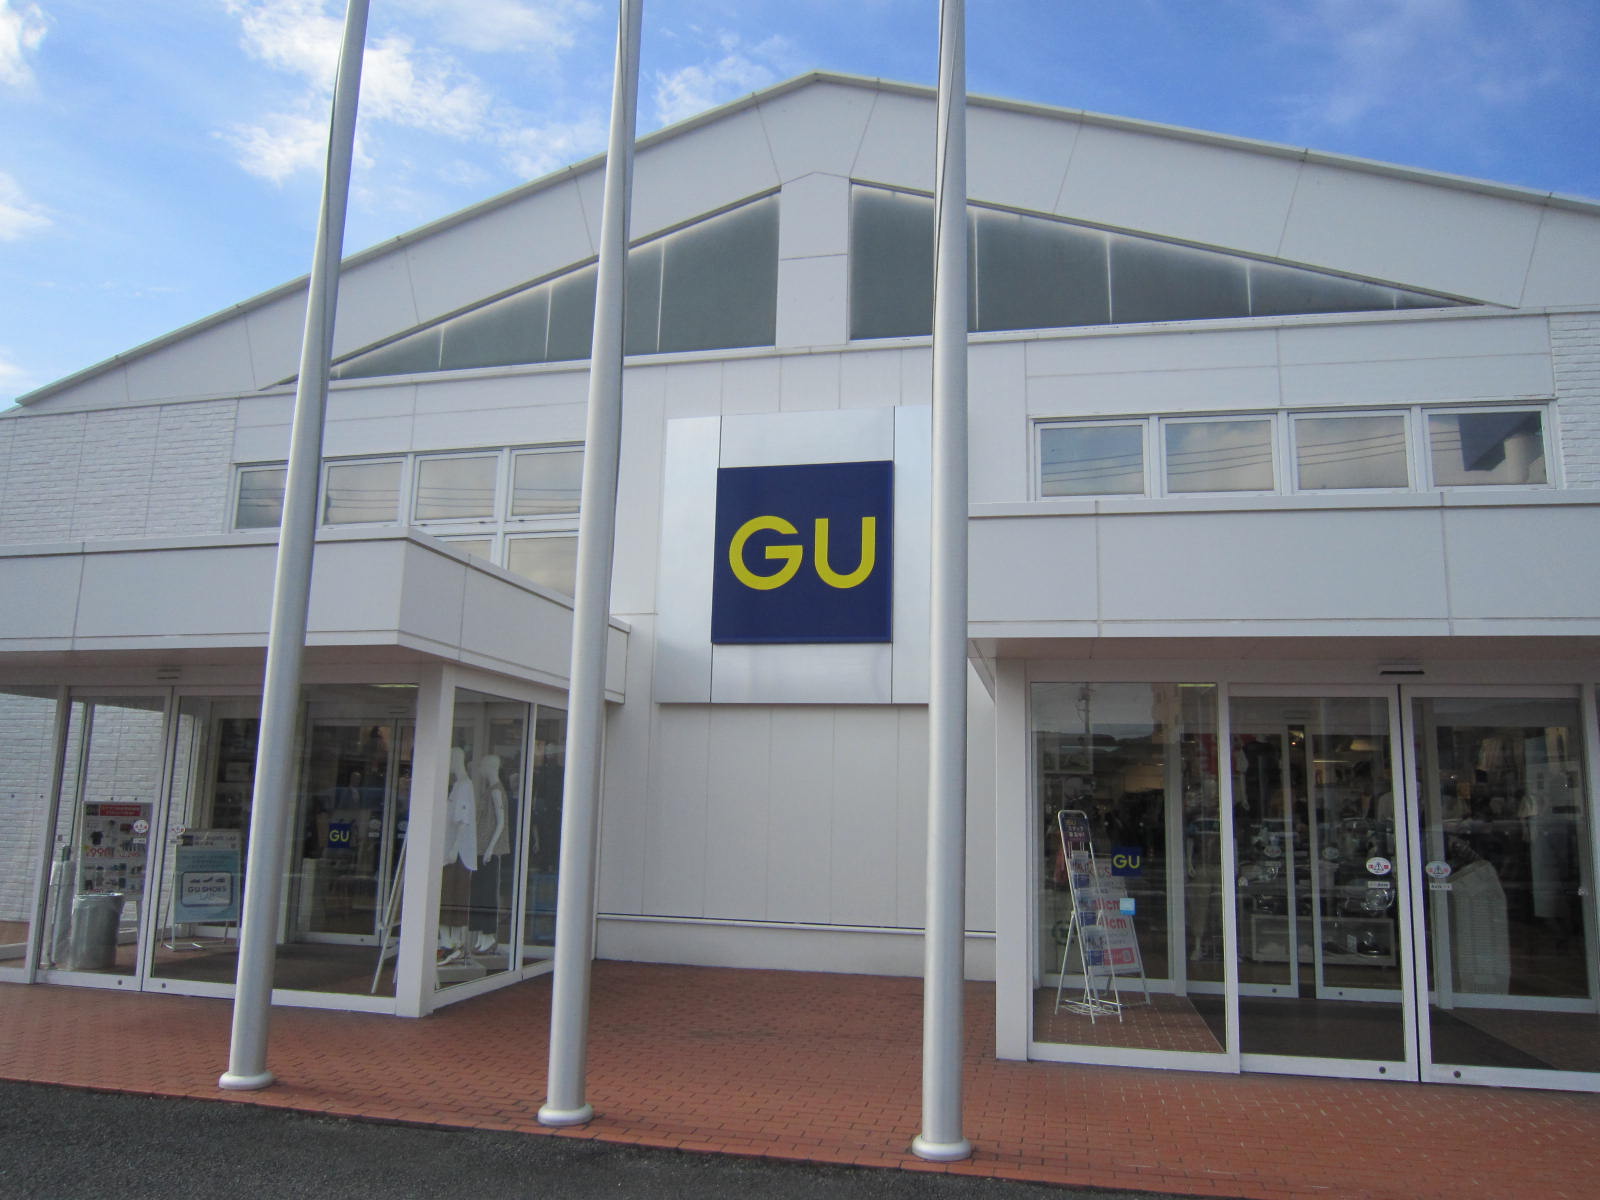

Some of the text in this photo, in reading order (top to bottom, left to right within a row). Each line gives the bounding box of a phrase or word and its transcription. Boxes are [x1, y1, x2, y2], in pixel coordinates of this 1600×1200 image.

[729, 515, 876, 591] GU
[329, 829, 350, 842] GU
[1112, 853, 1141, 869] GU
